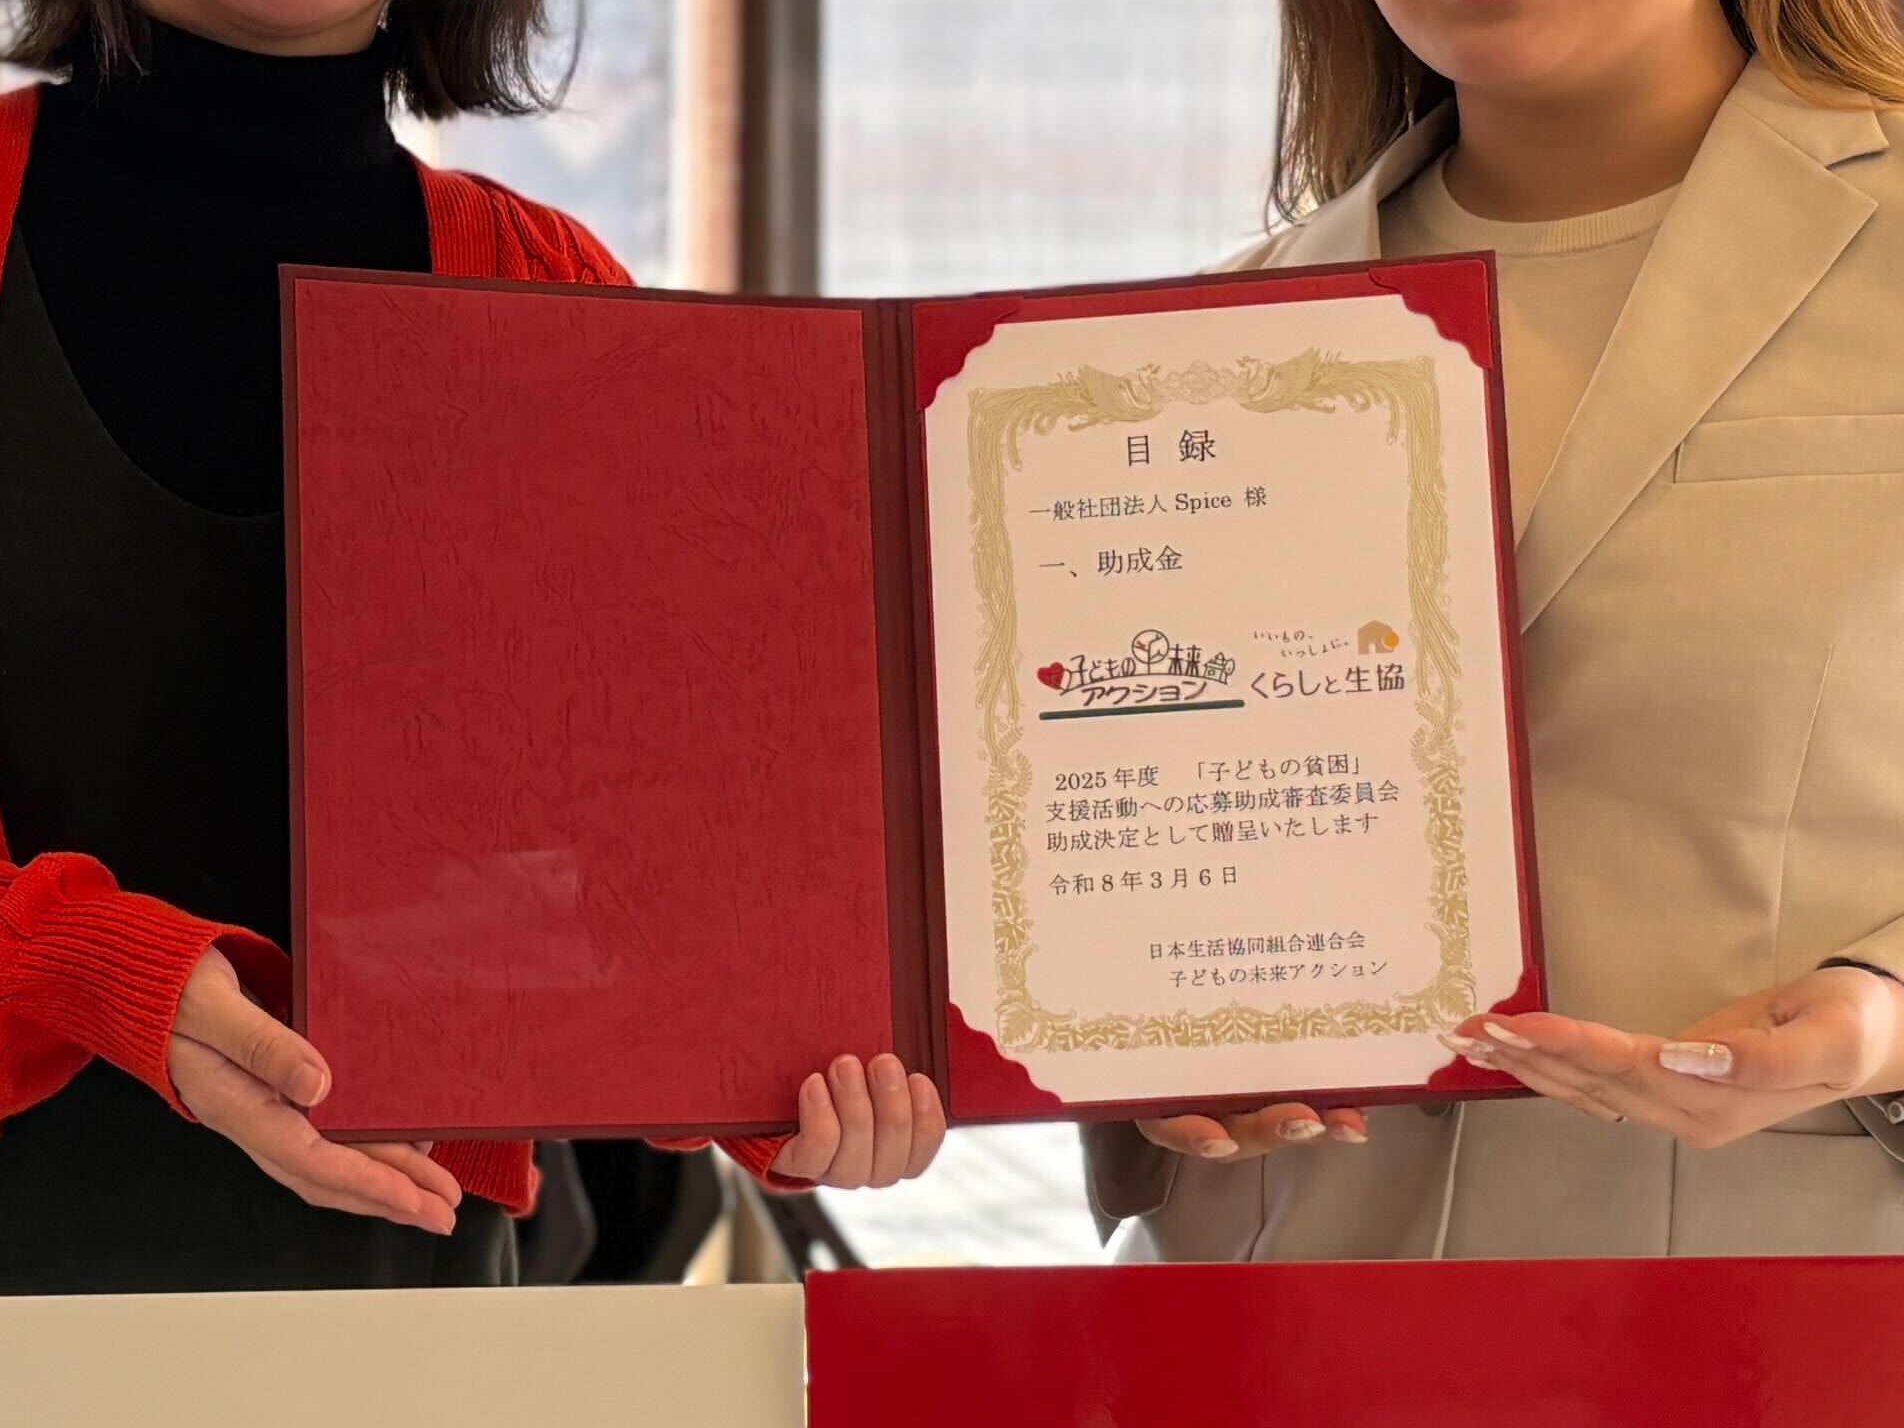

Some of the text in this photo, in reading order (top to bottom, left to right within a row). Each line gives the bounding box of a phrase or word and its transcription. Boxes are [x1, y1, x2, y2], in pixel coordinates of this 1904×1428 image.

[1175, 492, 1232, 515] Spice
[1244, 486, 1268, 509] 様
[1081, 680, 1207, 708] アクション
[1250, 662, 1405, 700] くらしと生協
[1197, 752, 1361, 783] 「子どもの貧困」
[1046, 778, 1400, 823] 支援活動への応募助成審査委員会
[1046, 812, 1380, 854] 助成決定として贈呈いたします
[1149, 930, 1366, 960] 日本生活協同組合連合会
[1168, 961, 1388, 989] 子どもの未来アクション
